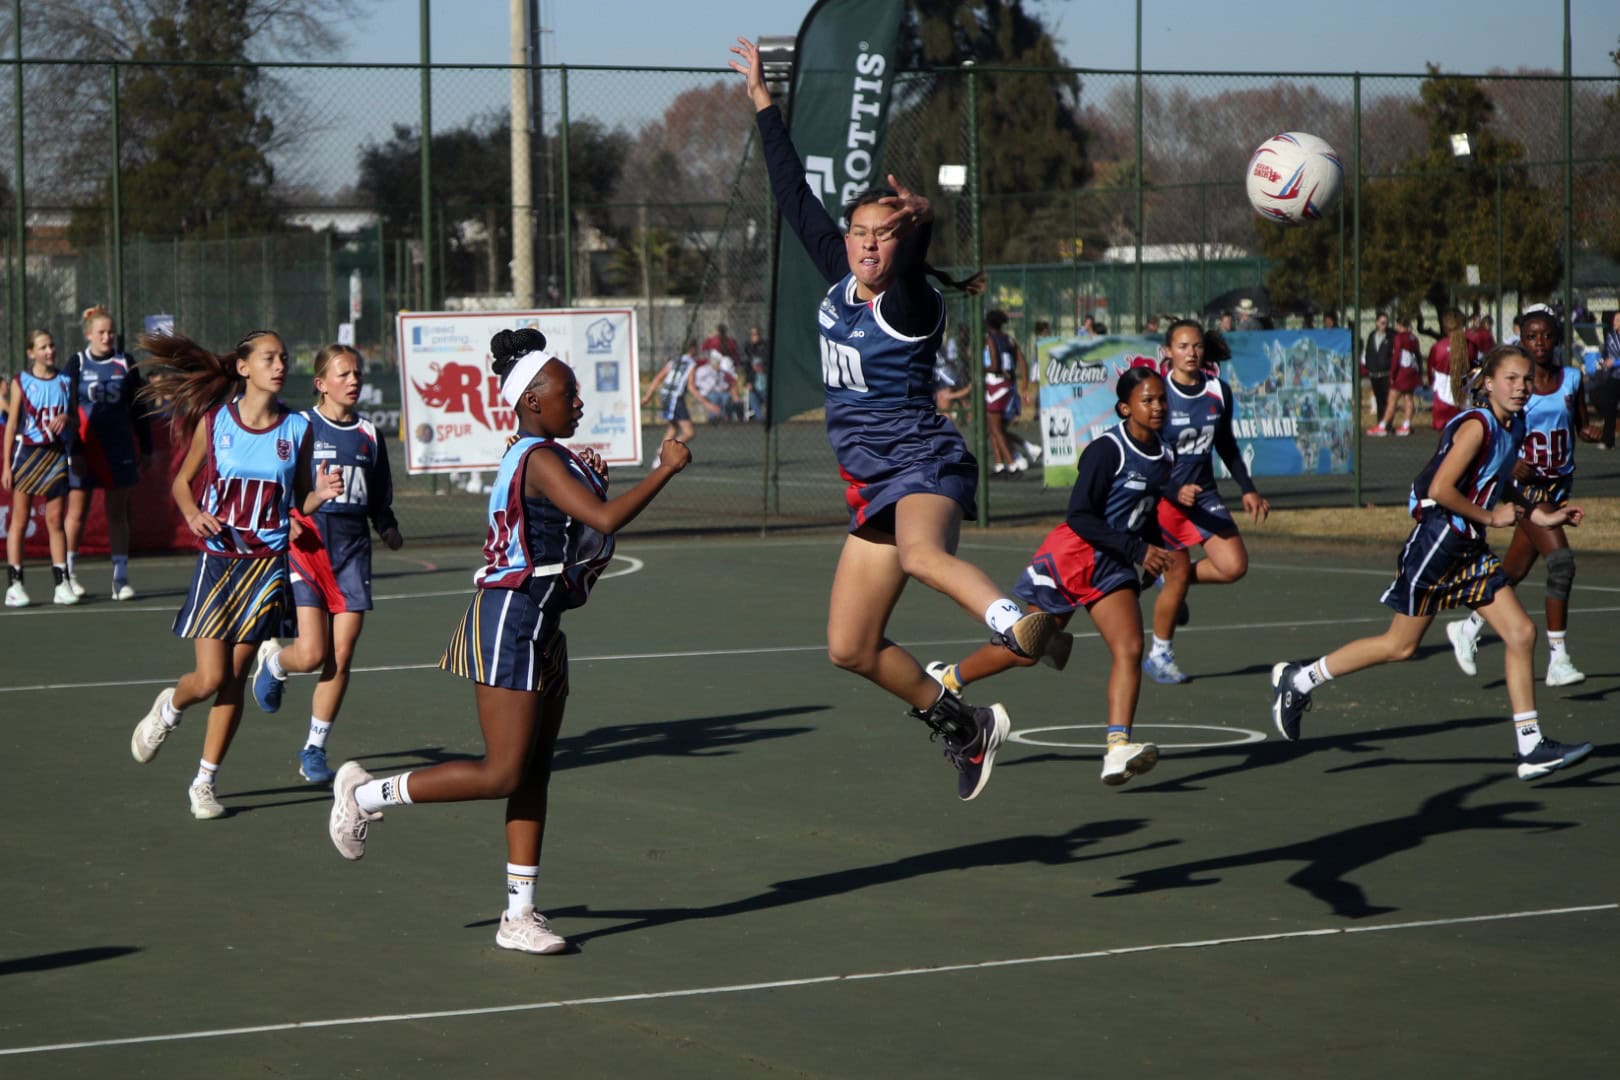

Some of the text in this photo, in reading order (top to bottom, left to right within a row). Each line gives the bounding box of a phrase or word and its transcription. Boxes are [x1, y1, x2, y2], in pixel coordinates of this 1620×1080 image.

[838, 53, 886, 230] ROTTIS
[87, 381, 122, 403] GS
[436, 424, 473, 442] SPUR
[1261, 416, 1299, 438] MADE
